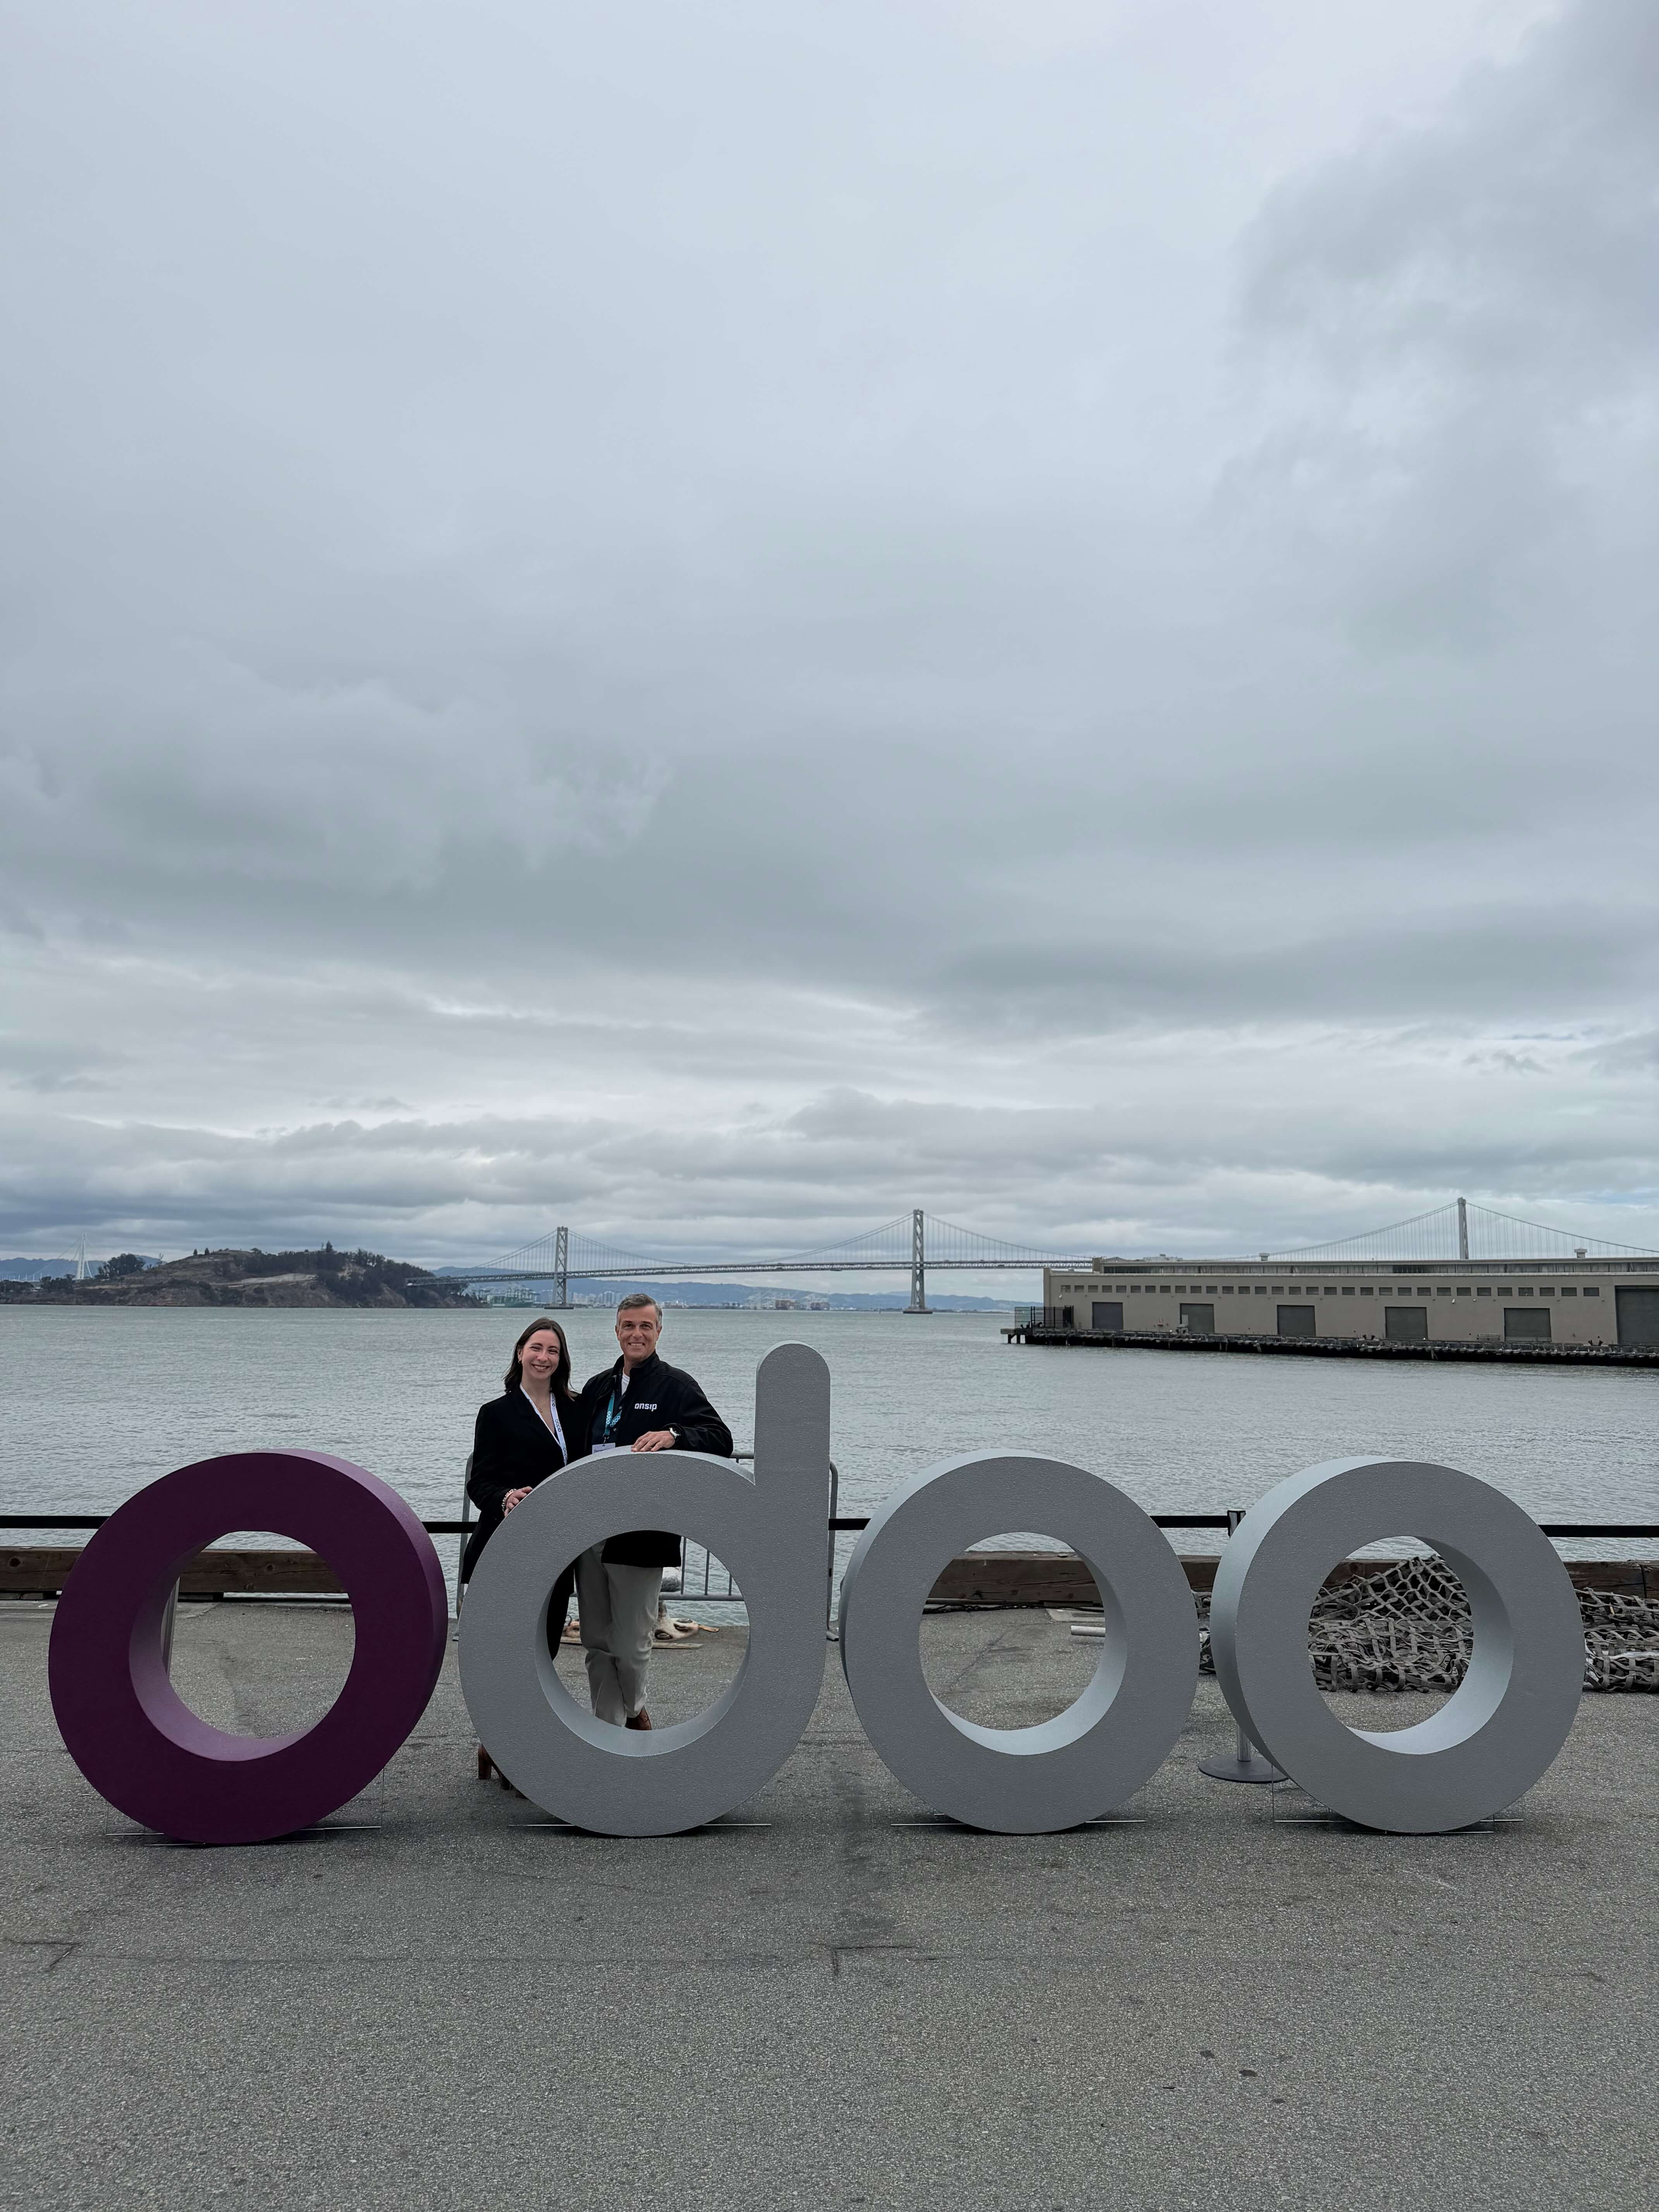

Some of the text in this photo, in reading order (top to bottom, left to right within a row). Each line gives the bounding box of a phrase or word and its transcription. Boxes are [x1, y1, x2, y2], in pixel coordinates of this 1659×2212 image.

[634, 1403, 657, 1412] onsip
[610, 1415, 621, 1427] odoo
[49, 1340, 1585, 1844] odoo
